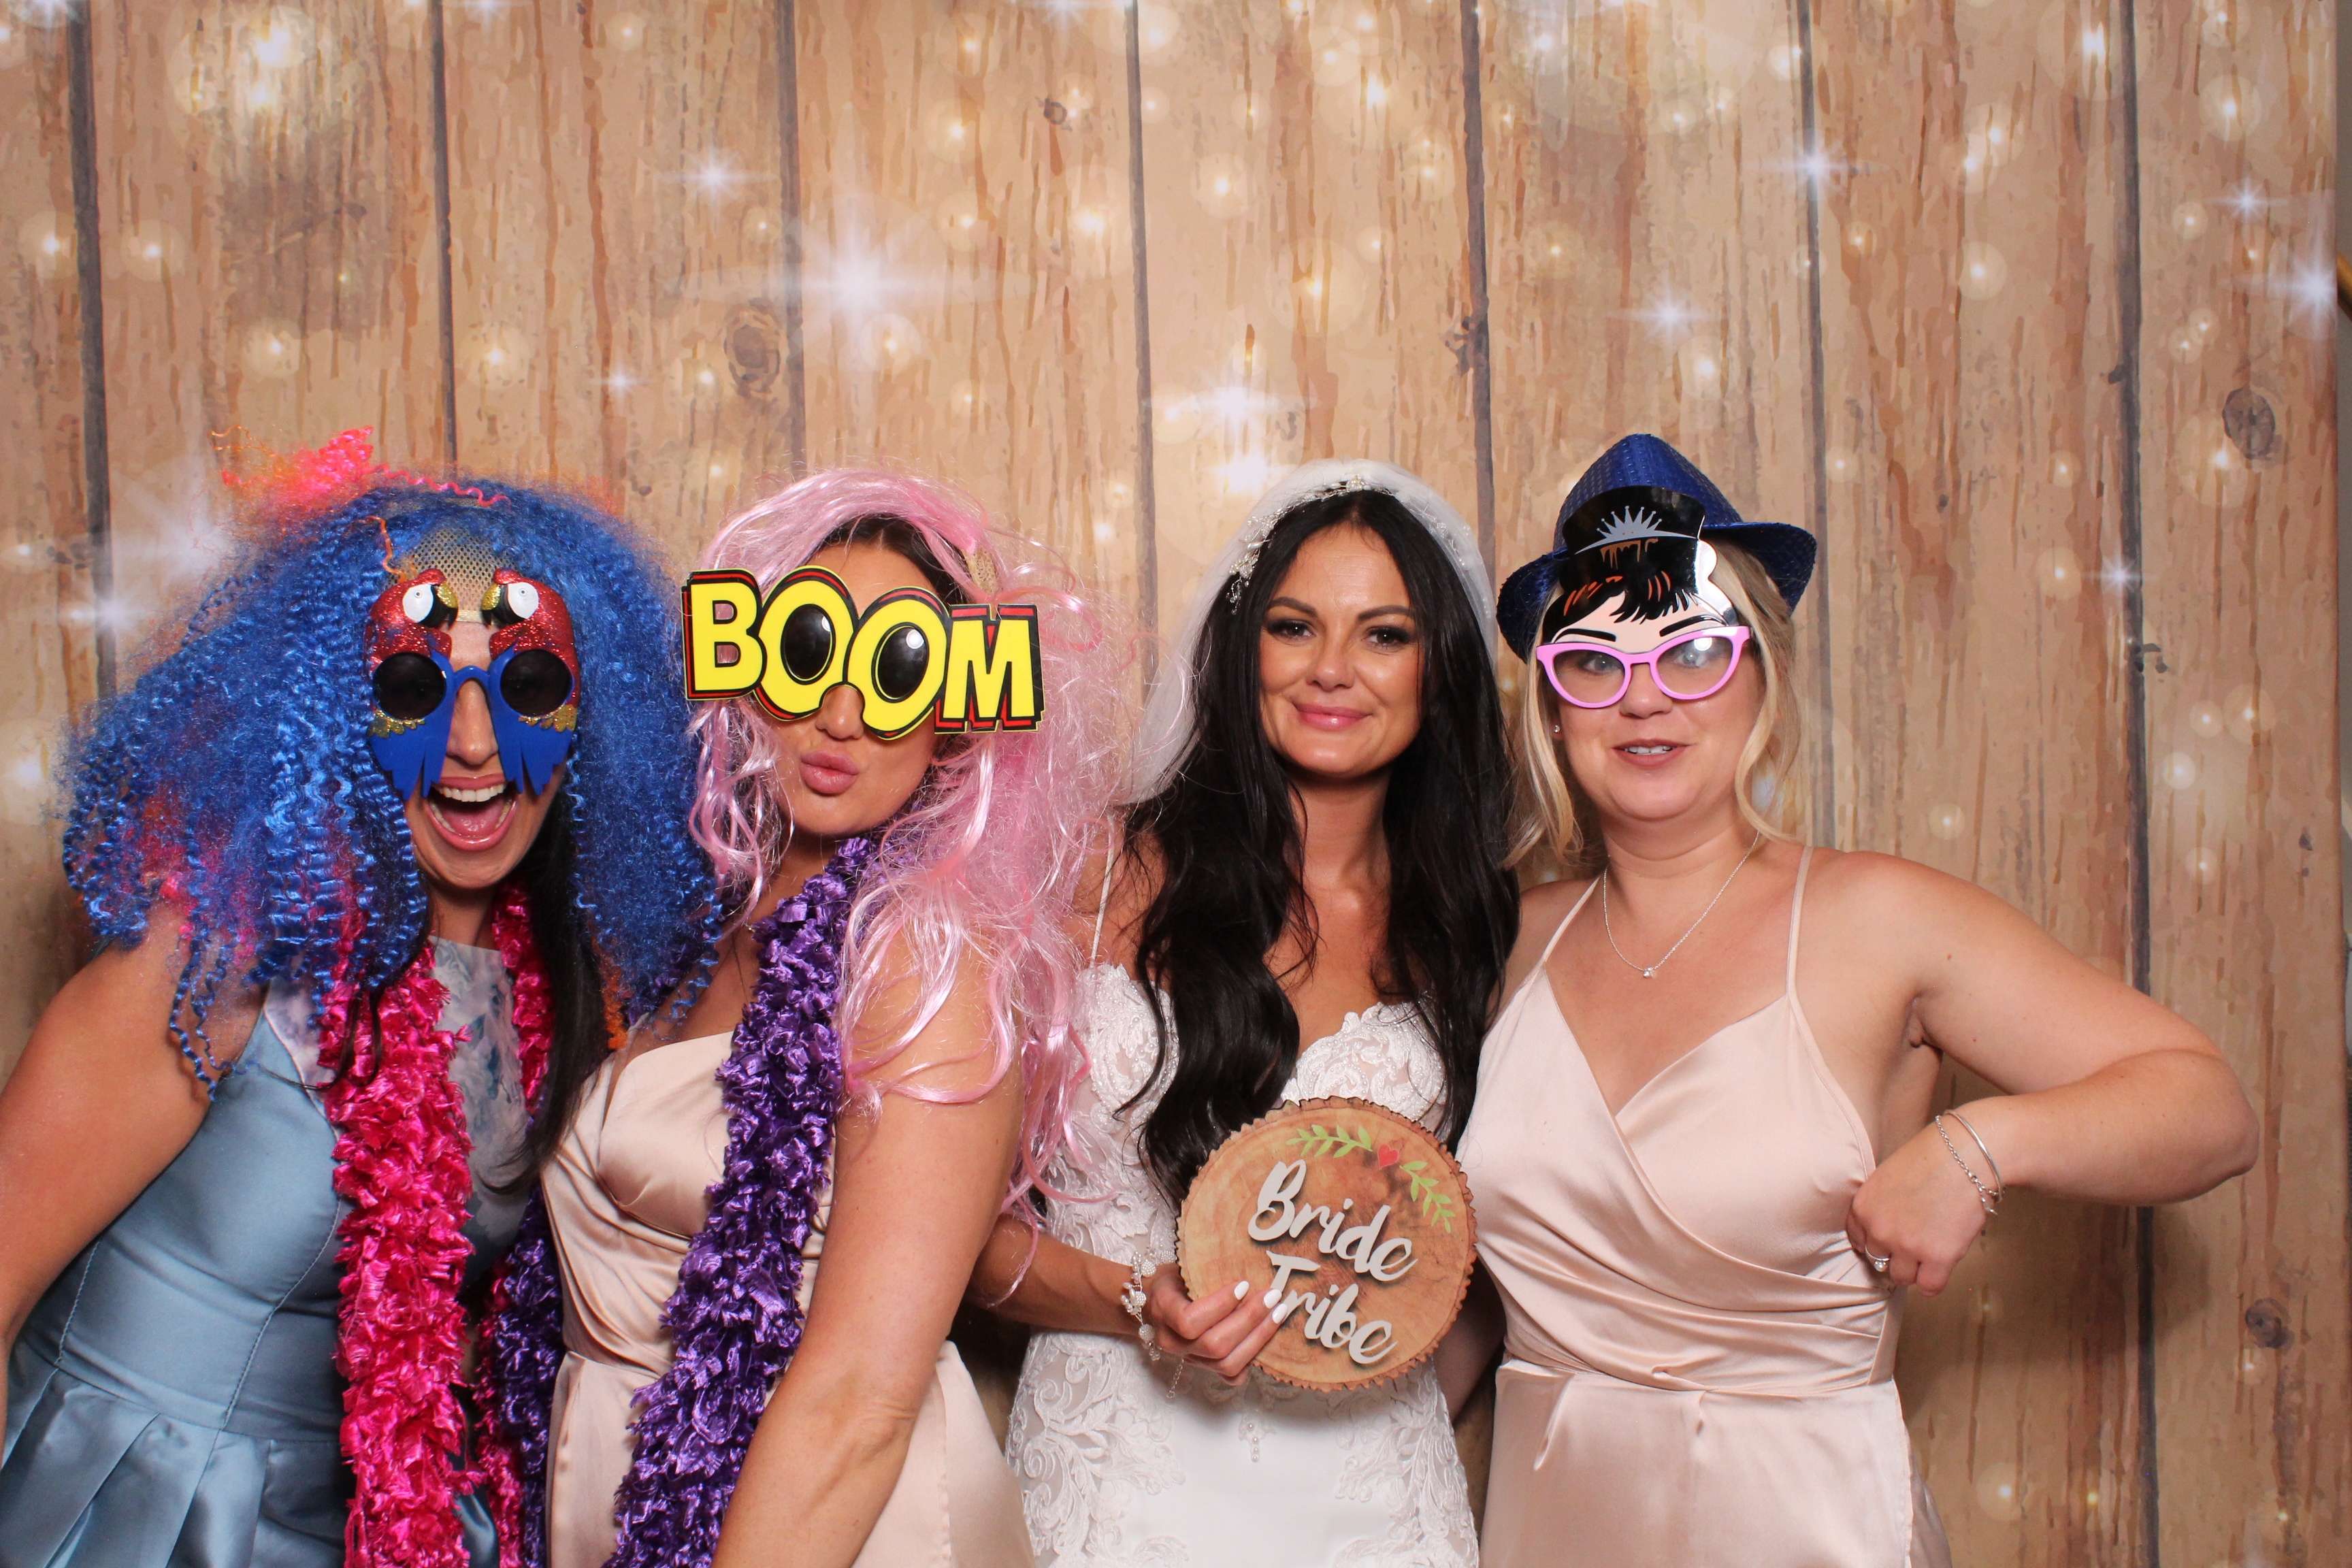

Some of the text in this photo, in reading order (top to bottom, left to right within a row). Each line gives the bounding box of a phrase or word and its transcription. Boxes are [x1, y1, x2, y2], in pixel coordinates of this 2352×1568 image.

[683, 566, 1045, 740] BOOM
[1247, 1158, 1418, 1281] Bride
[1266, 1250, 1398, 1364] Tribe
